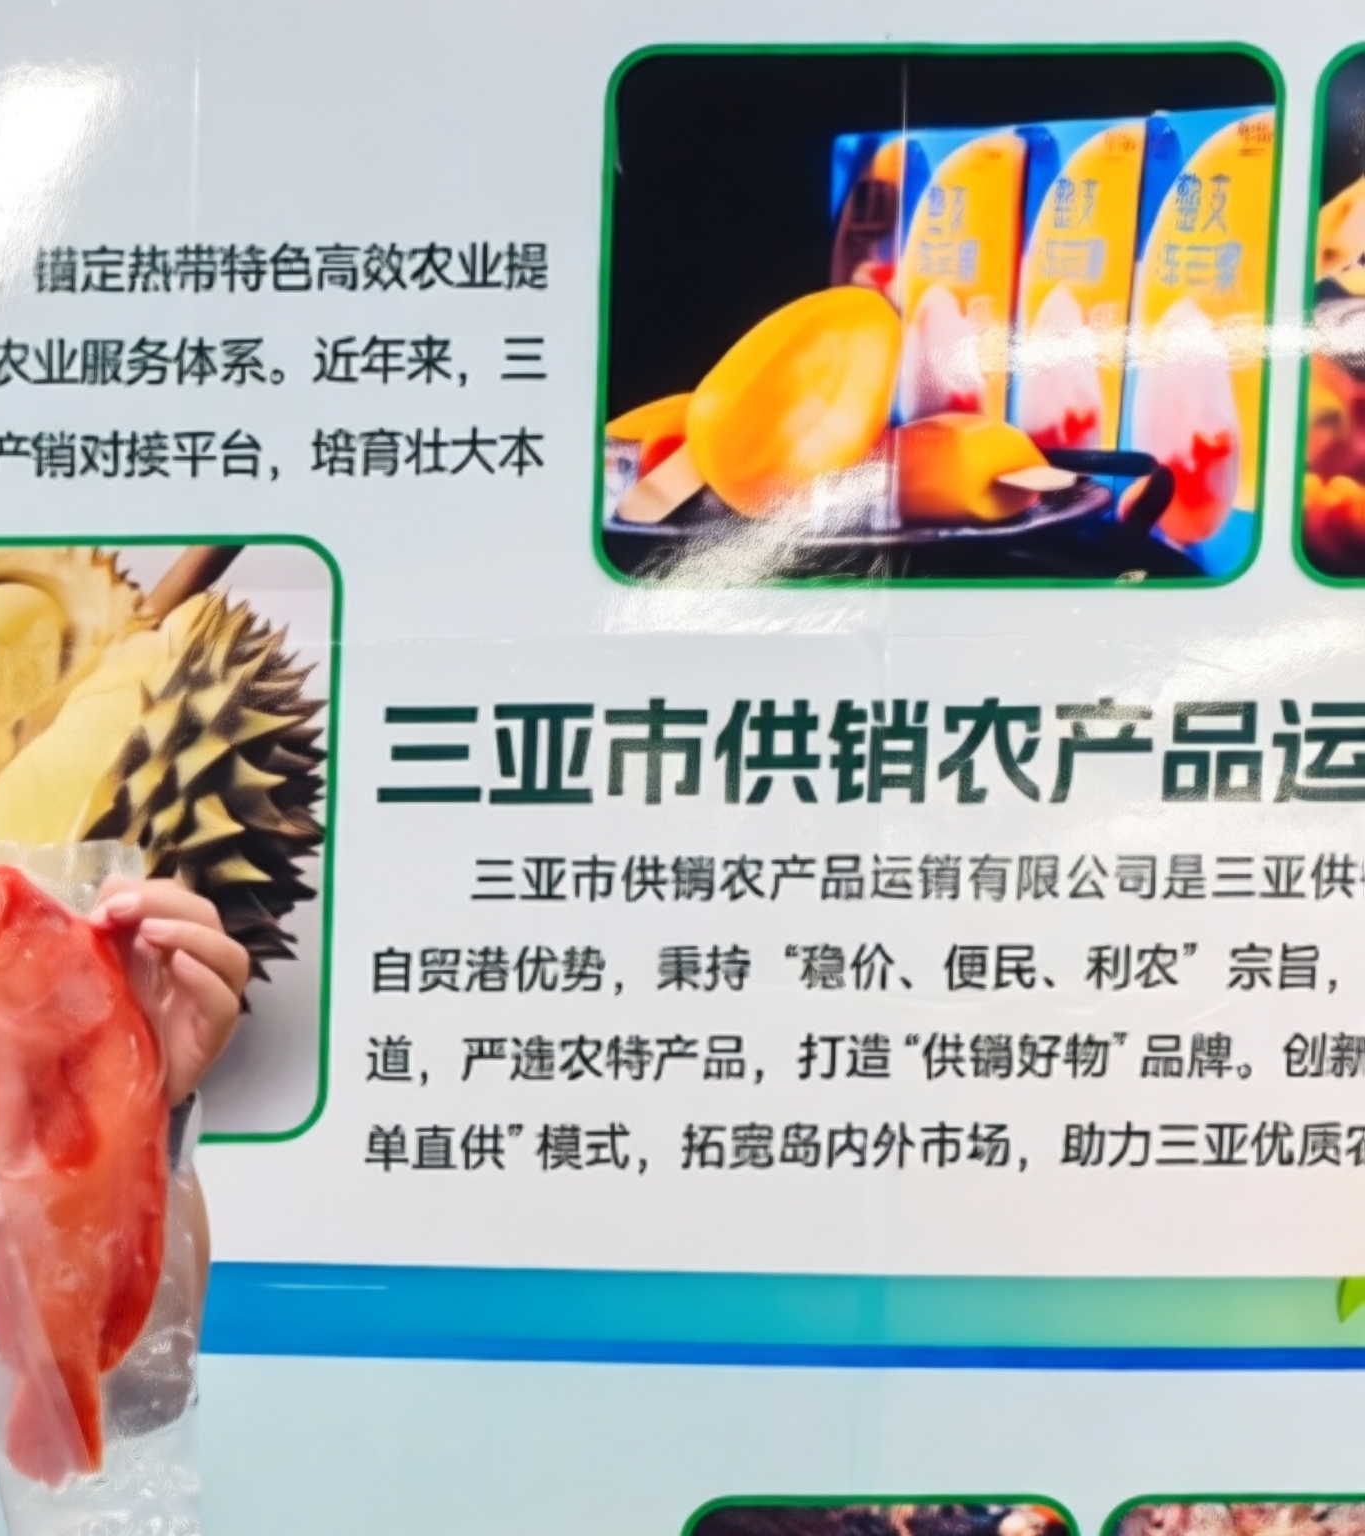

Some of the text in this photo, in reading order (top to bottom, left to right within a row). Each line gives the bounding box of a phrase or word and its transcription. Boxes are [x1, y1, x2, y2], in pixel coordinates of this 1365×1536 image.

[376, 696, 1365, 804] 三亚市供销农产品运
[471, 852, 1365, 903] 三亚市供销农产品运销有限公司是三亚供
